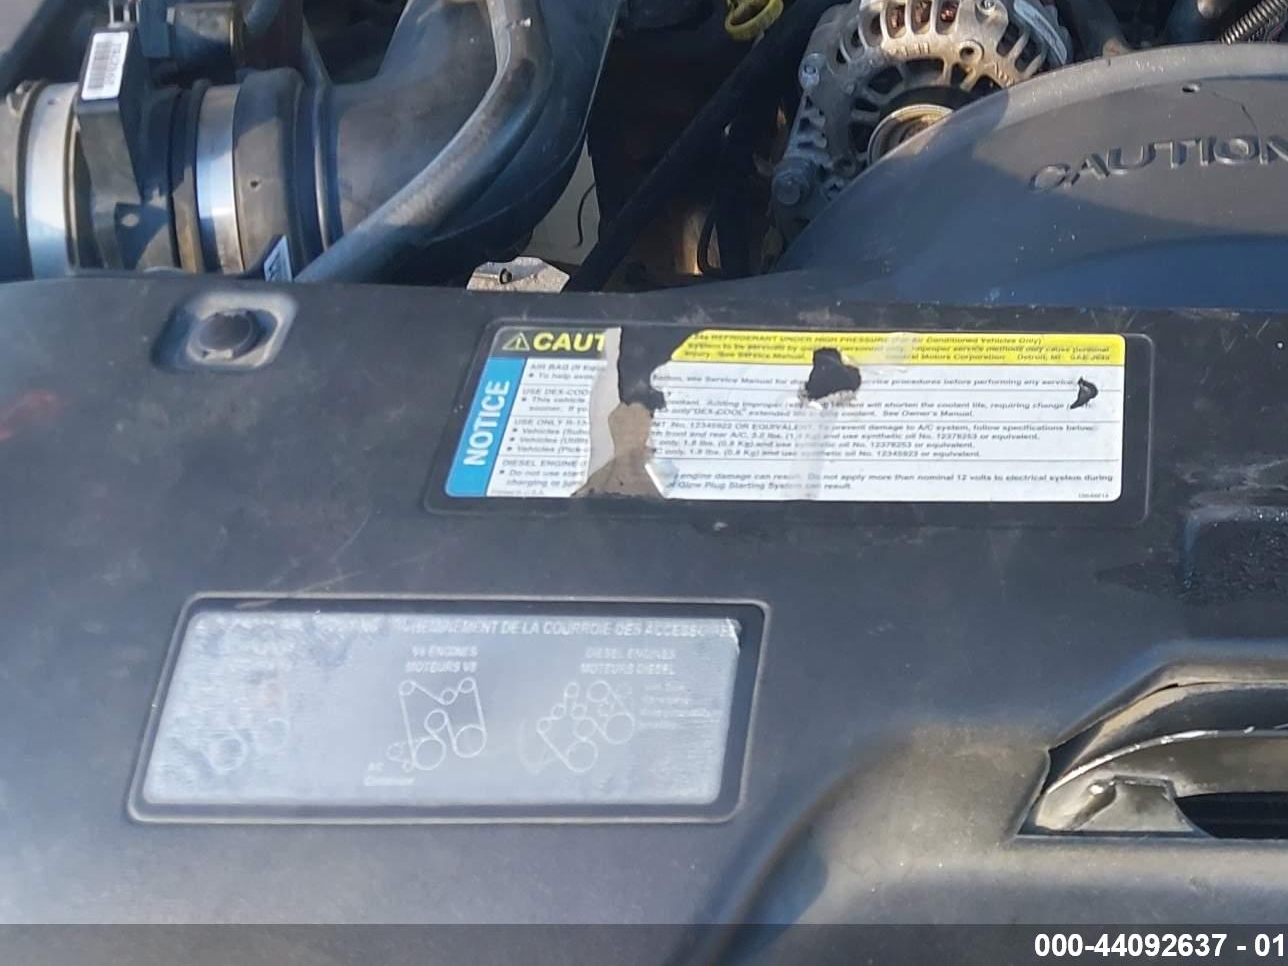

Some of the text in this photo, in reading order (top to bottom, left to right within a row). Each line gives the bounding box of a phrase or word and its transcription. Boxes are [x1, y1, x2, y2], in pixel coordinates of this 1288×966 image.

[463, 380, 510, 466] NOTICE
[502, 620, 520, 635] DE
[522, 620, 540, 635] LA
